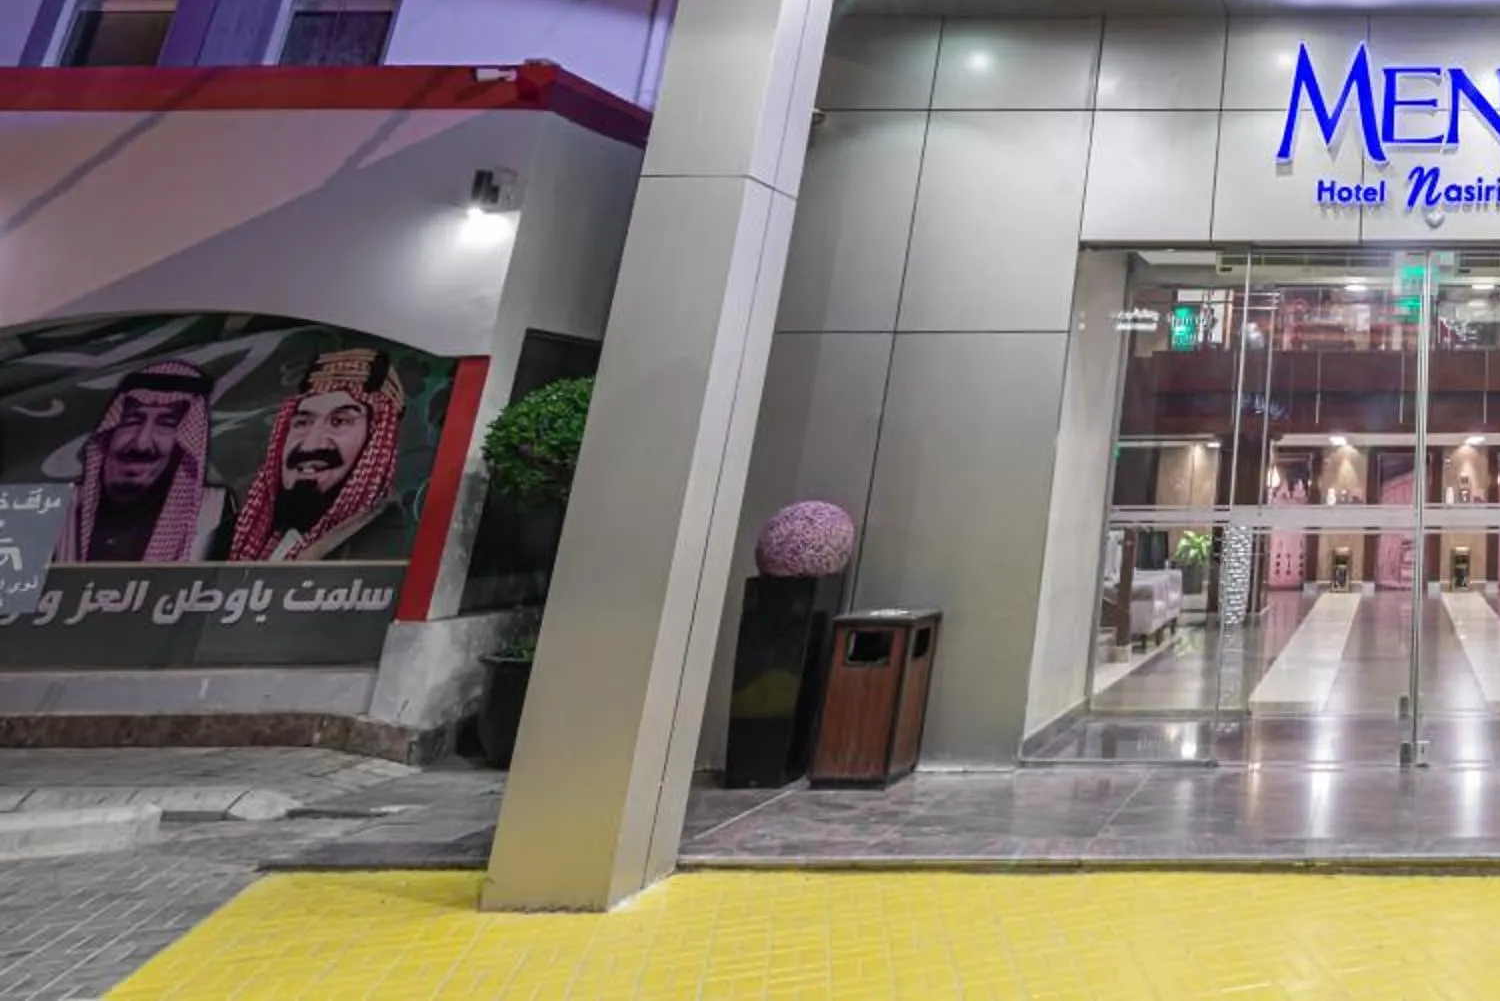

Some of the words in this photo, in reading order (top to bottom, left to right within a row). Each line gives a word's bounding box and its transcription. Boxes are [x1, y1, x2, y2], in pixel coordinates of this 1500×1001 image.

[1317, 180, 1385, 203] Hotel
[64, 580, 150, 625] العز
[282, 579, 394, 611] سلمت
